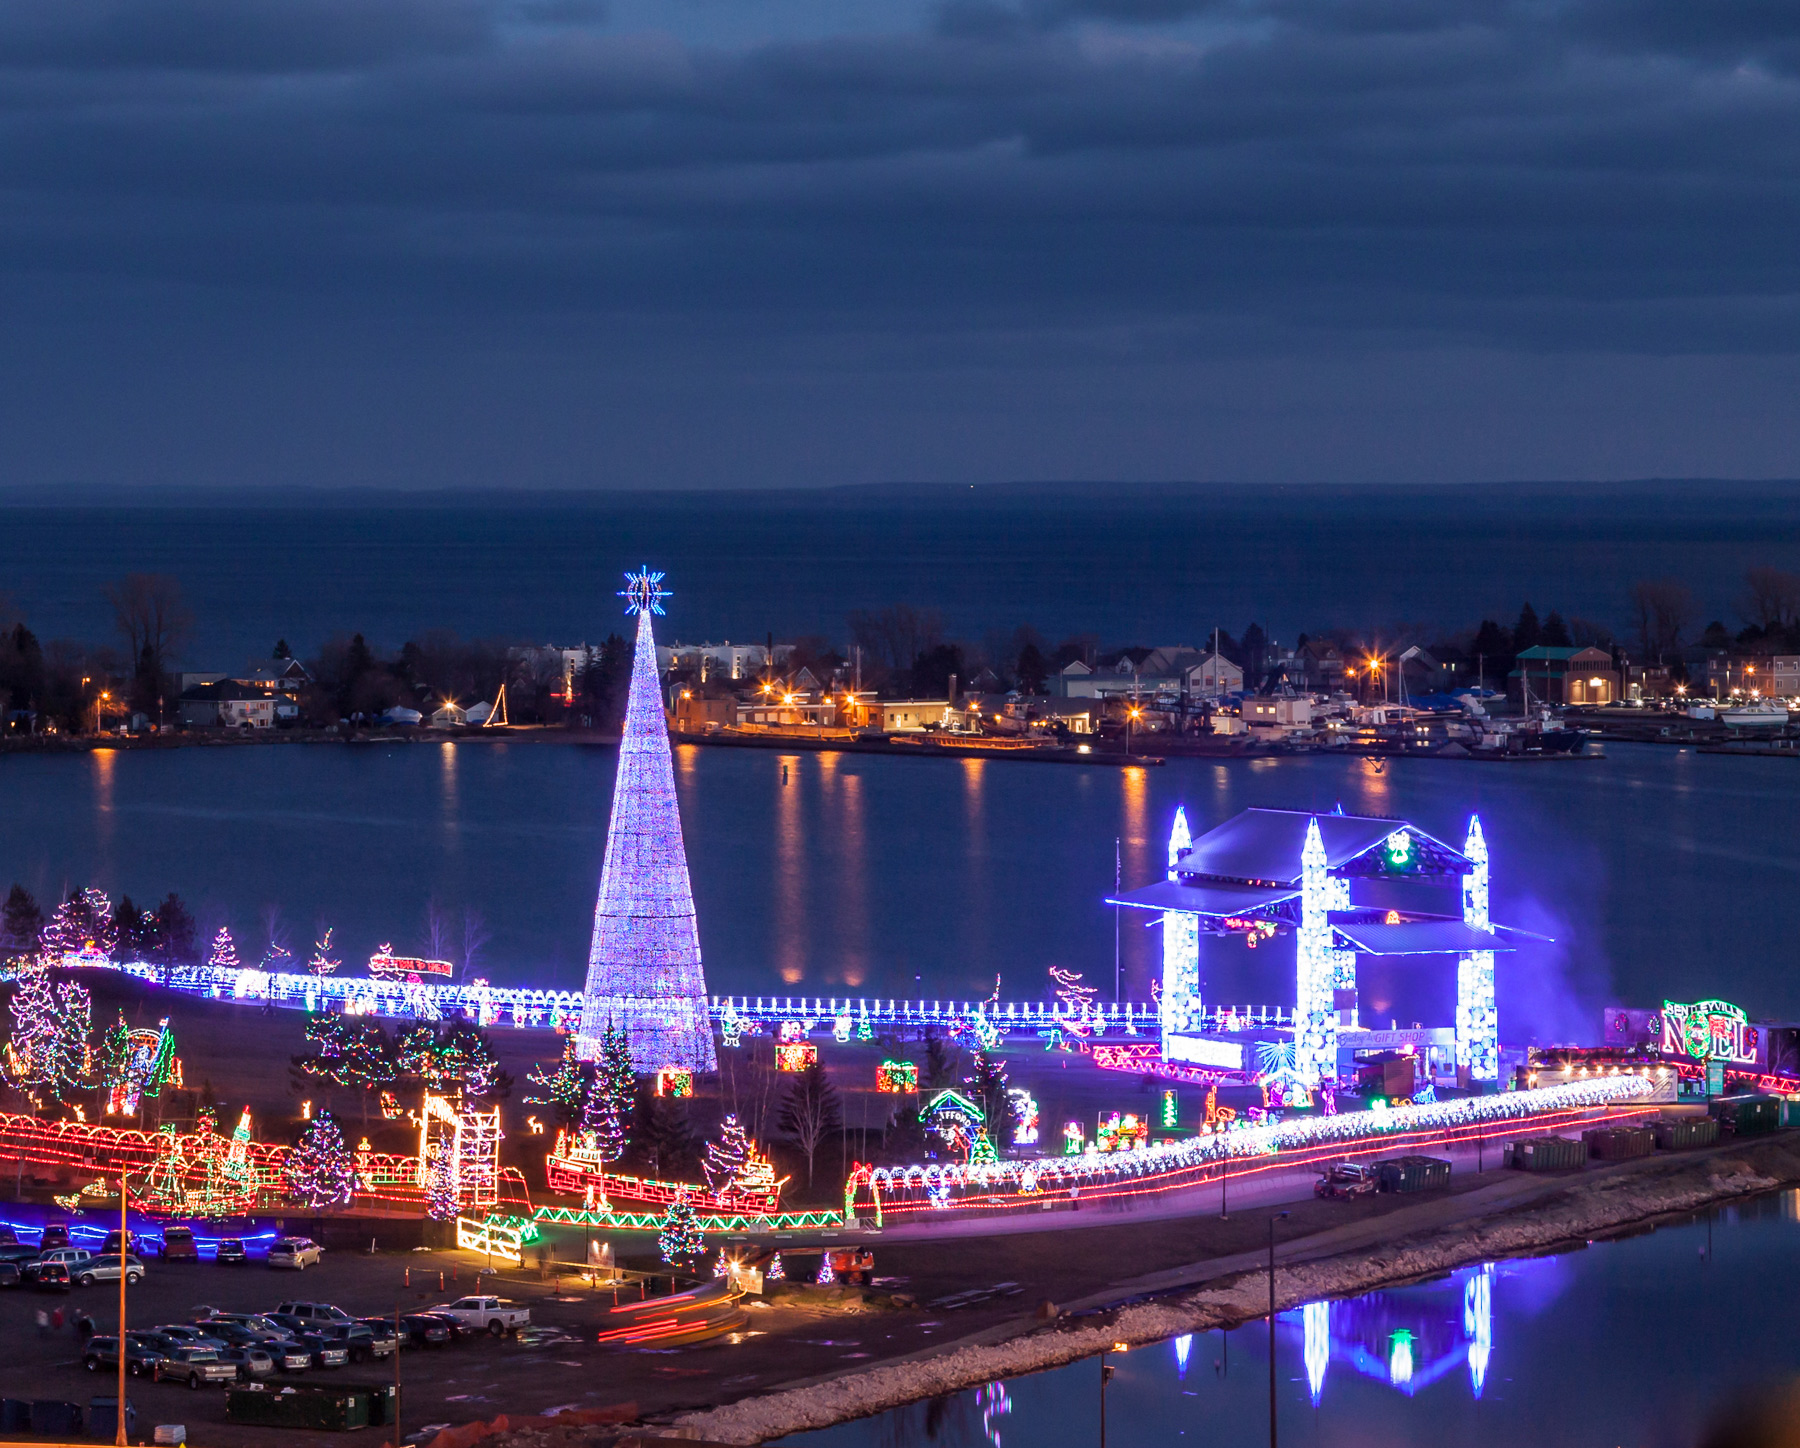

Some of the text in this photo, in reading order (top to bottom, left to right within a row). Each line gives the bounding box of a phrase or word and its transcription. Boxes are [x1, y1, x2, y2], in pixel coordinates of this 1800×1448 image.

[1666, 1000, 1744, 1019] BENTLEYVILLE
[1374, 1032, 1397, 1043] GIFT
[1399, 1031, 1426, 1042] SHOP
[1660, 1009, 1757, 1064] NOEL
